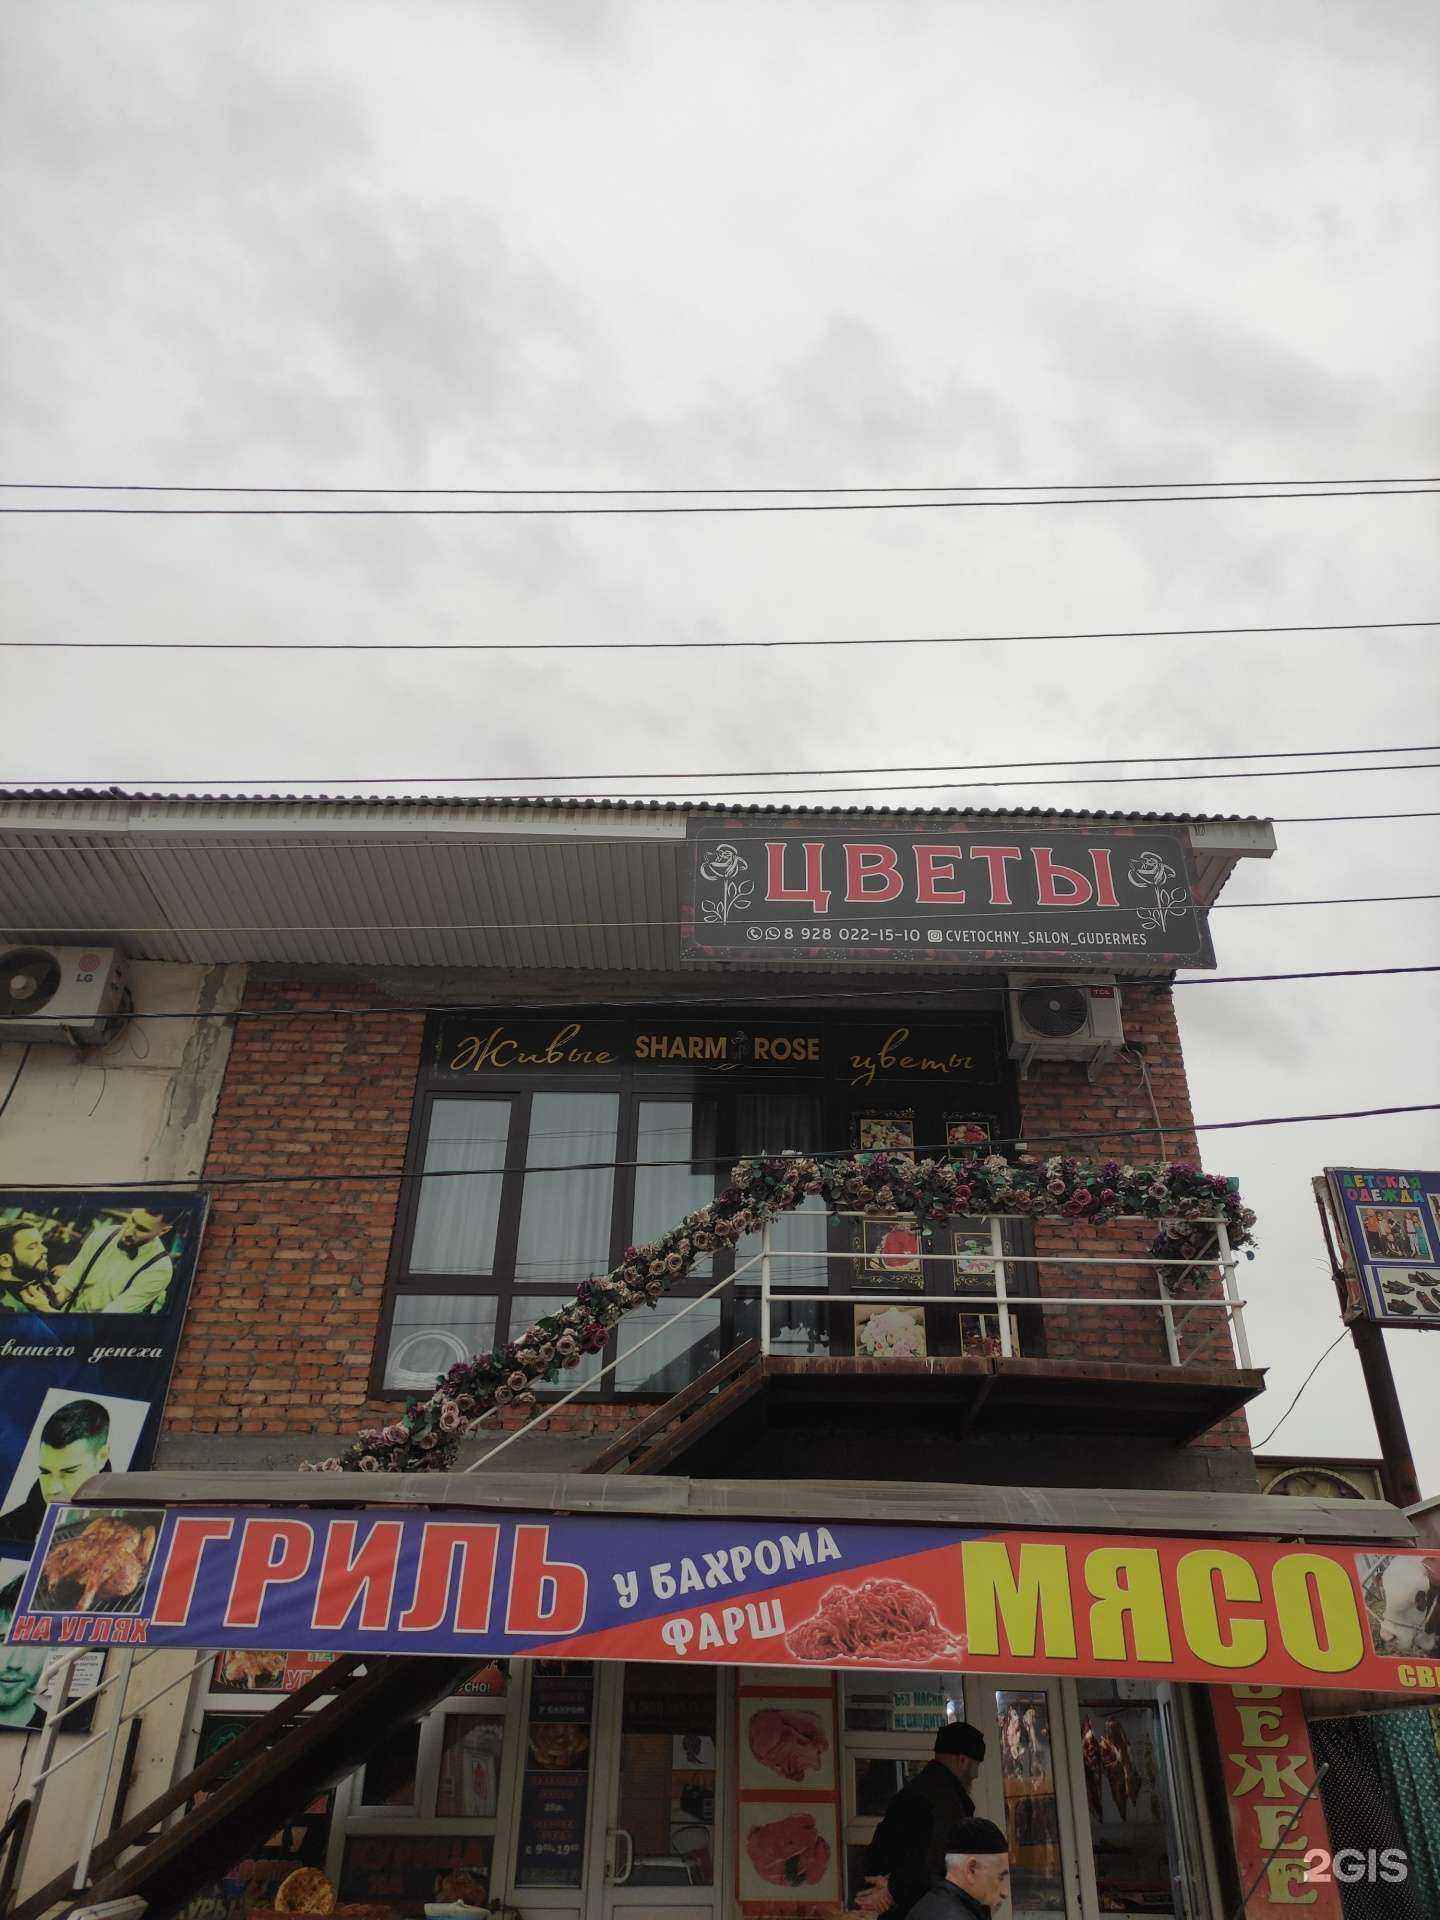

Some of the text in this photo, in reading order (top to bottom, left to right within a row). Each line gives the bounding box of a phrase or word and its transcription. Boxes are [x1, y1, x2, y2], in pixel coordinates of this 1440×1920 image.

[763, 841, 1121, 914] ЦВЕТЫ
[784, 928, 921, 942] 8 928 022-15-10
[946, 930, 1147, 946] CVETOCHNY_SALON_GUDERMES
[76, 973, 94, 983] LG
[450, 1023, 617, 1072] Живые
[634, 1035, 821, 1061] SHARM ROSE
[849, 1027, 976, 1087] цветы
[1343, 1174, 1421, 1189] ДЕТСКАЯ
[1346, 1188, 1425, 1202] ОДЕЖДА
[87, 1345, 162, 1364] успеха
[150, 1516, 588, 1636] ГРИЛЬ
[650, 1526, 842, 1600] БАХРОМА
[961, 1540, 1365, 1673] МЯСО
[12, 1615, 151, 1643] НА УГЛЯХ
[661, 1598, 786, 1656] ФАРШ
[1398, 1664, 1440, 1688] СВ
